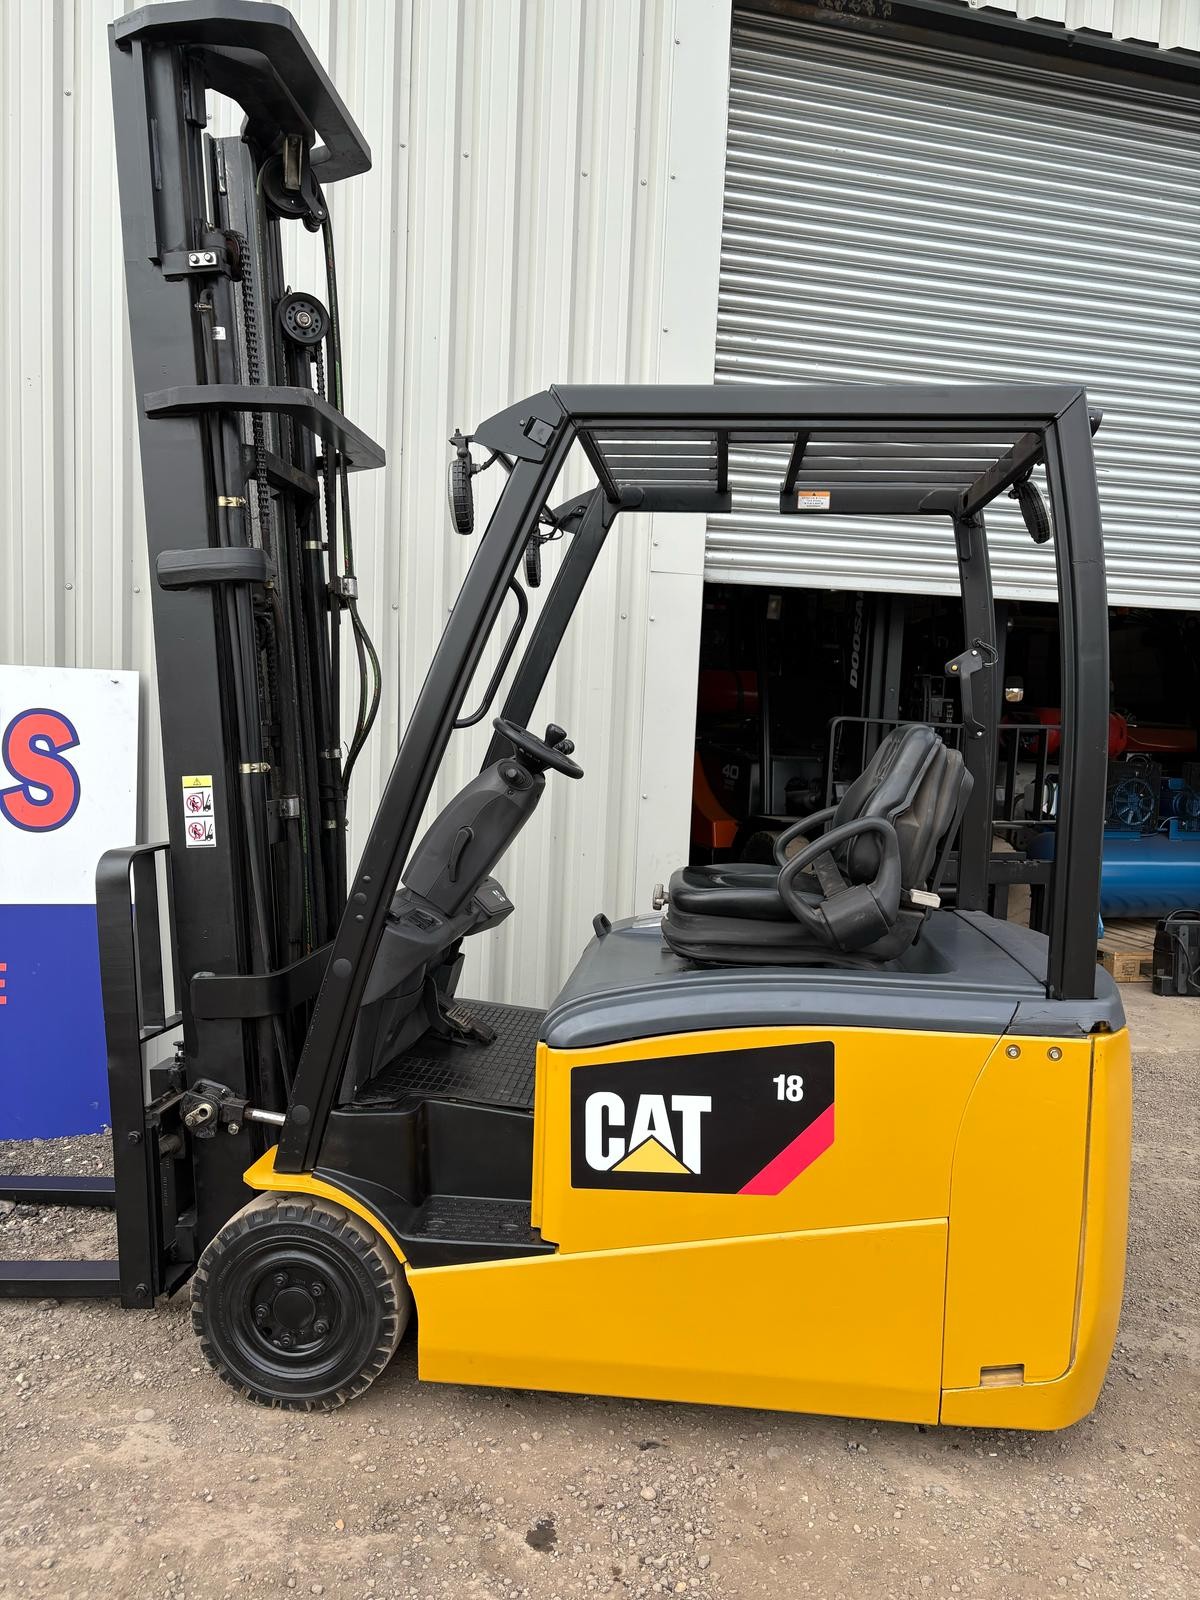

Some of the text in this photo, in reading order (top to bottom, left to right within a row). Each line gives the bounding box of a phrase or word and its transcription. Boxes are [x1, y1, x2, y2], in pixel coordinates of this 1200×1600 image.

[0, 708, 80, 833] S
[772, 1075, 804, 1102] 18
[586, 1092, 712, 1175] CAT
